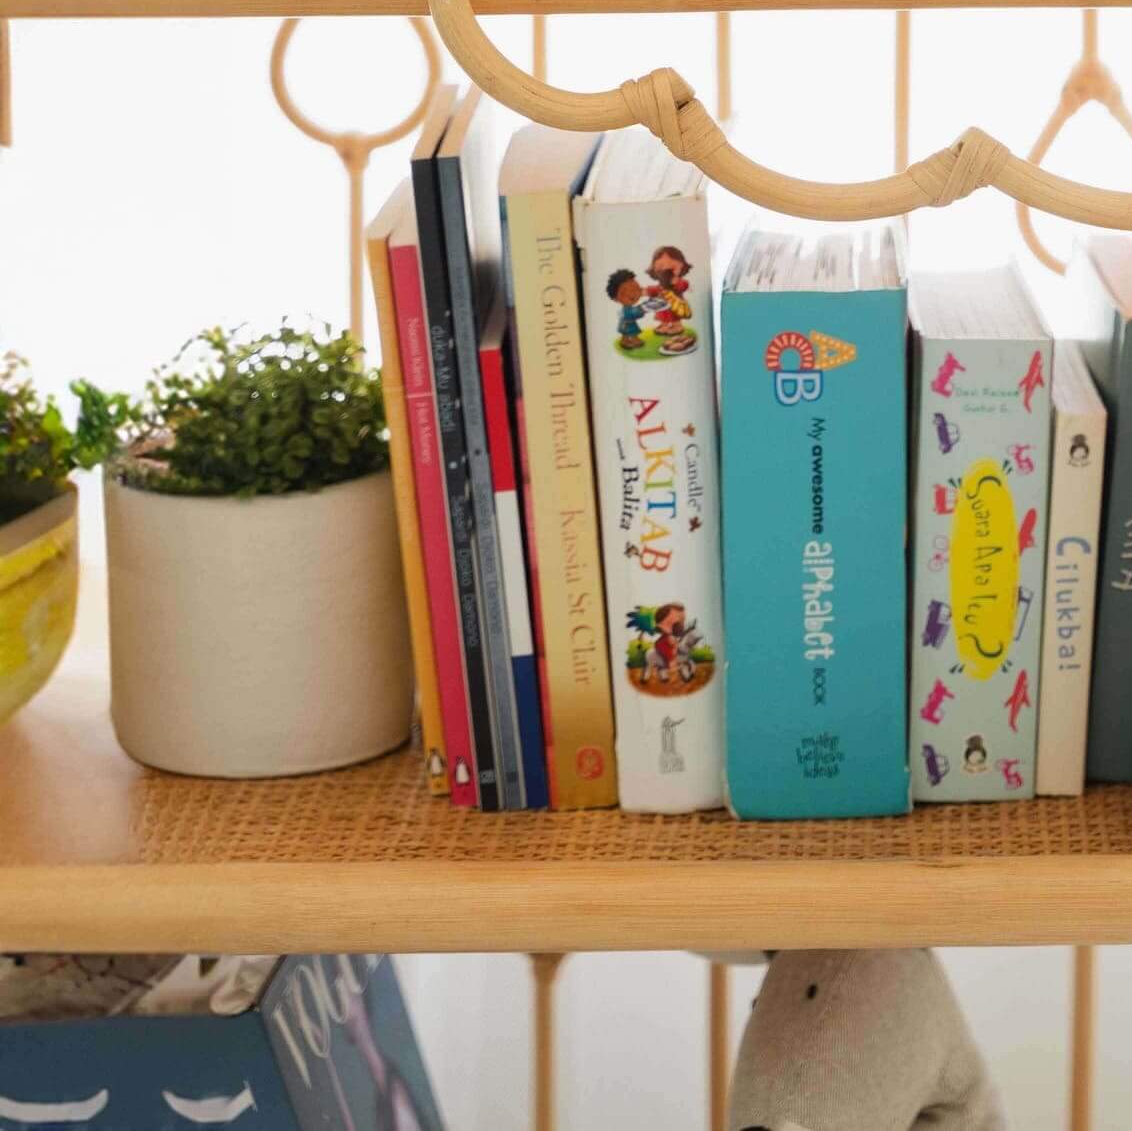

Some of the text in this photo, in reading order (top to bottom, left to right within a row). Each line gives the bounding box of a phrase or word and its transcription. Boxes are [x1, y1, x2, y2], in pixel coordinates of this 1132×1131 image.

[536, 228, 581, 470] The Golden Thread
[806, 418, 825, 441] My
[619, 466, 641, 531] Balita
[628, 396, 677, 572] ALKITAB
[811, 445, 825, 535] awesome
[966, 475, 1002, 538] Suara
[1055, 536, 1092, 671] Cilukba!
